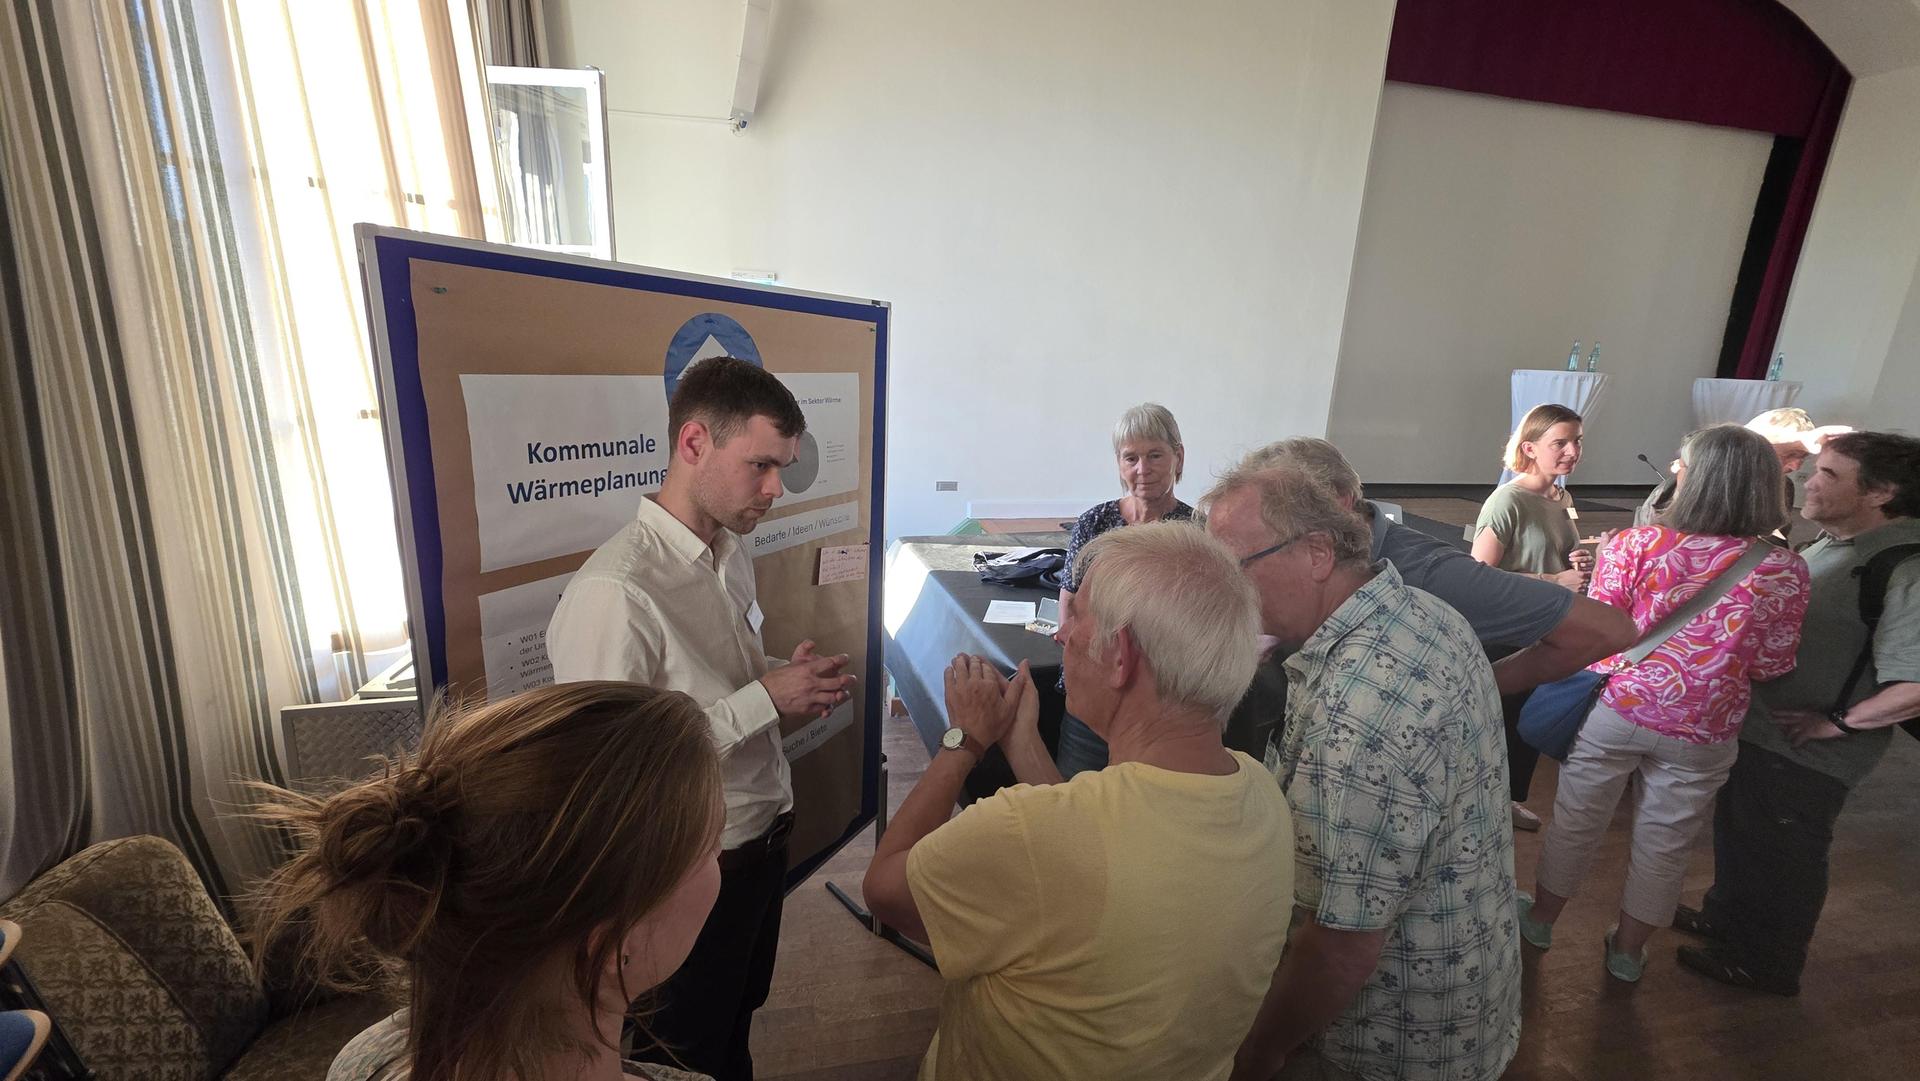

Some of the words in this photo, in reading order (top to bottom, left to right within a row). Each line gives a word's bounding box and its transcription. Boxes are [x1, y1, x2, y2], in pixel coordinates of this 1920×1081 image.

[527, 433, 656, 464] Kommunale
[507, 468, 668, 504] Wärmeplanung
[754, 530, 786, 547] Bedarfe
[792, 523, 813, 536] Ideen
[519, 633, 537, 644] W01
[519, 646, 533, 656] der
[521, 656, 539, 667] W02
[523, 679, 540, 690] W03
[810, 724, 828, 739] Biete
